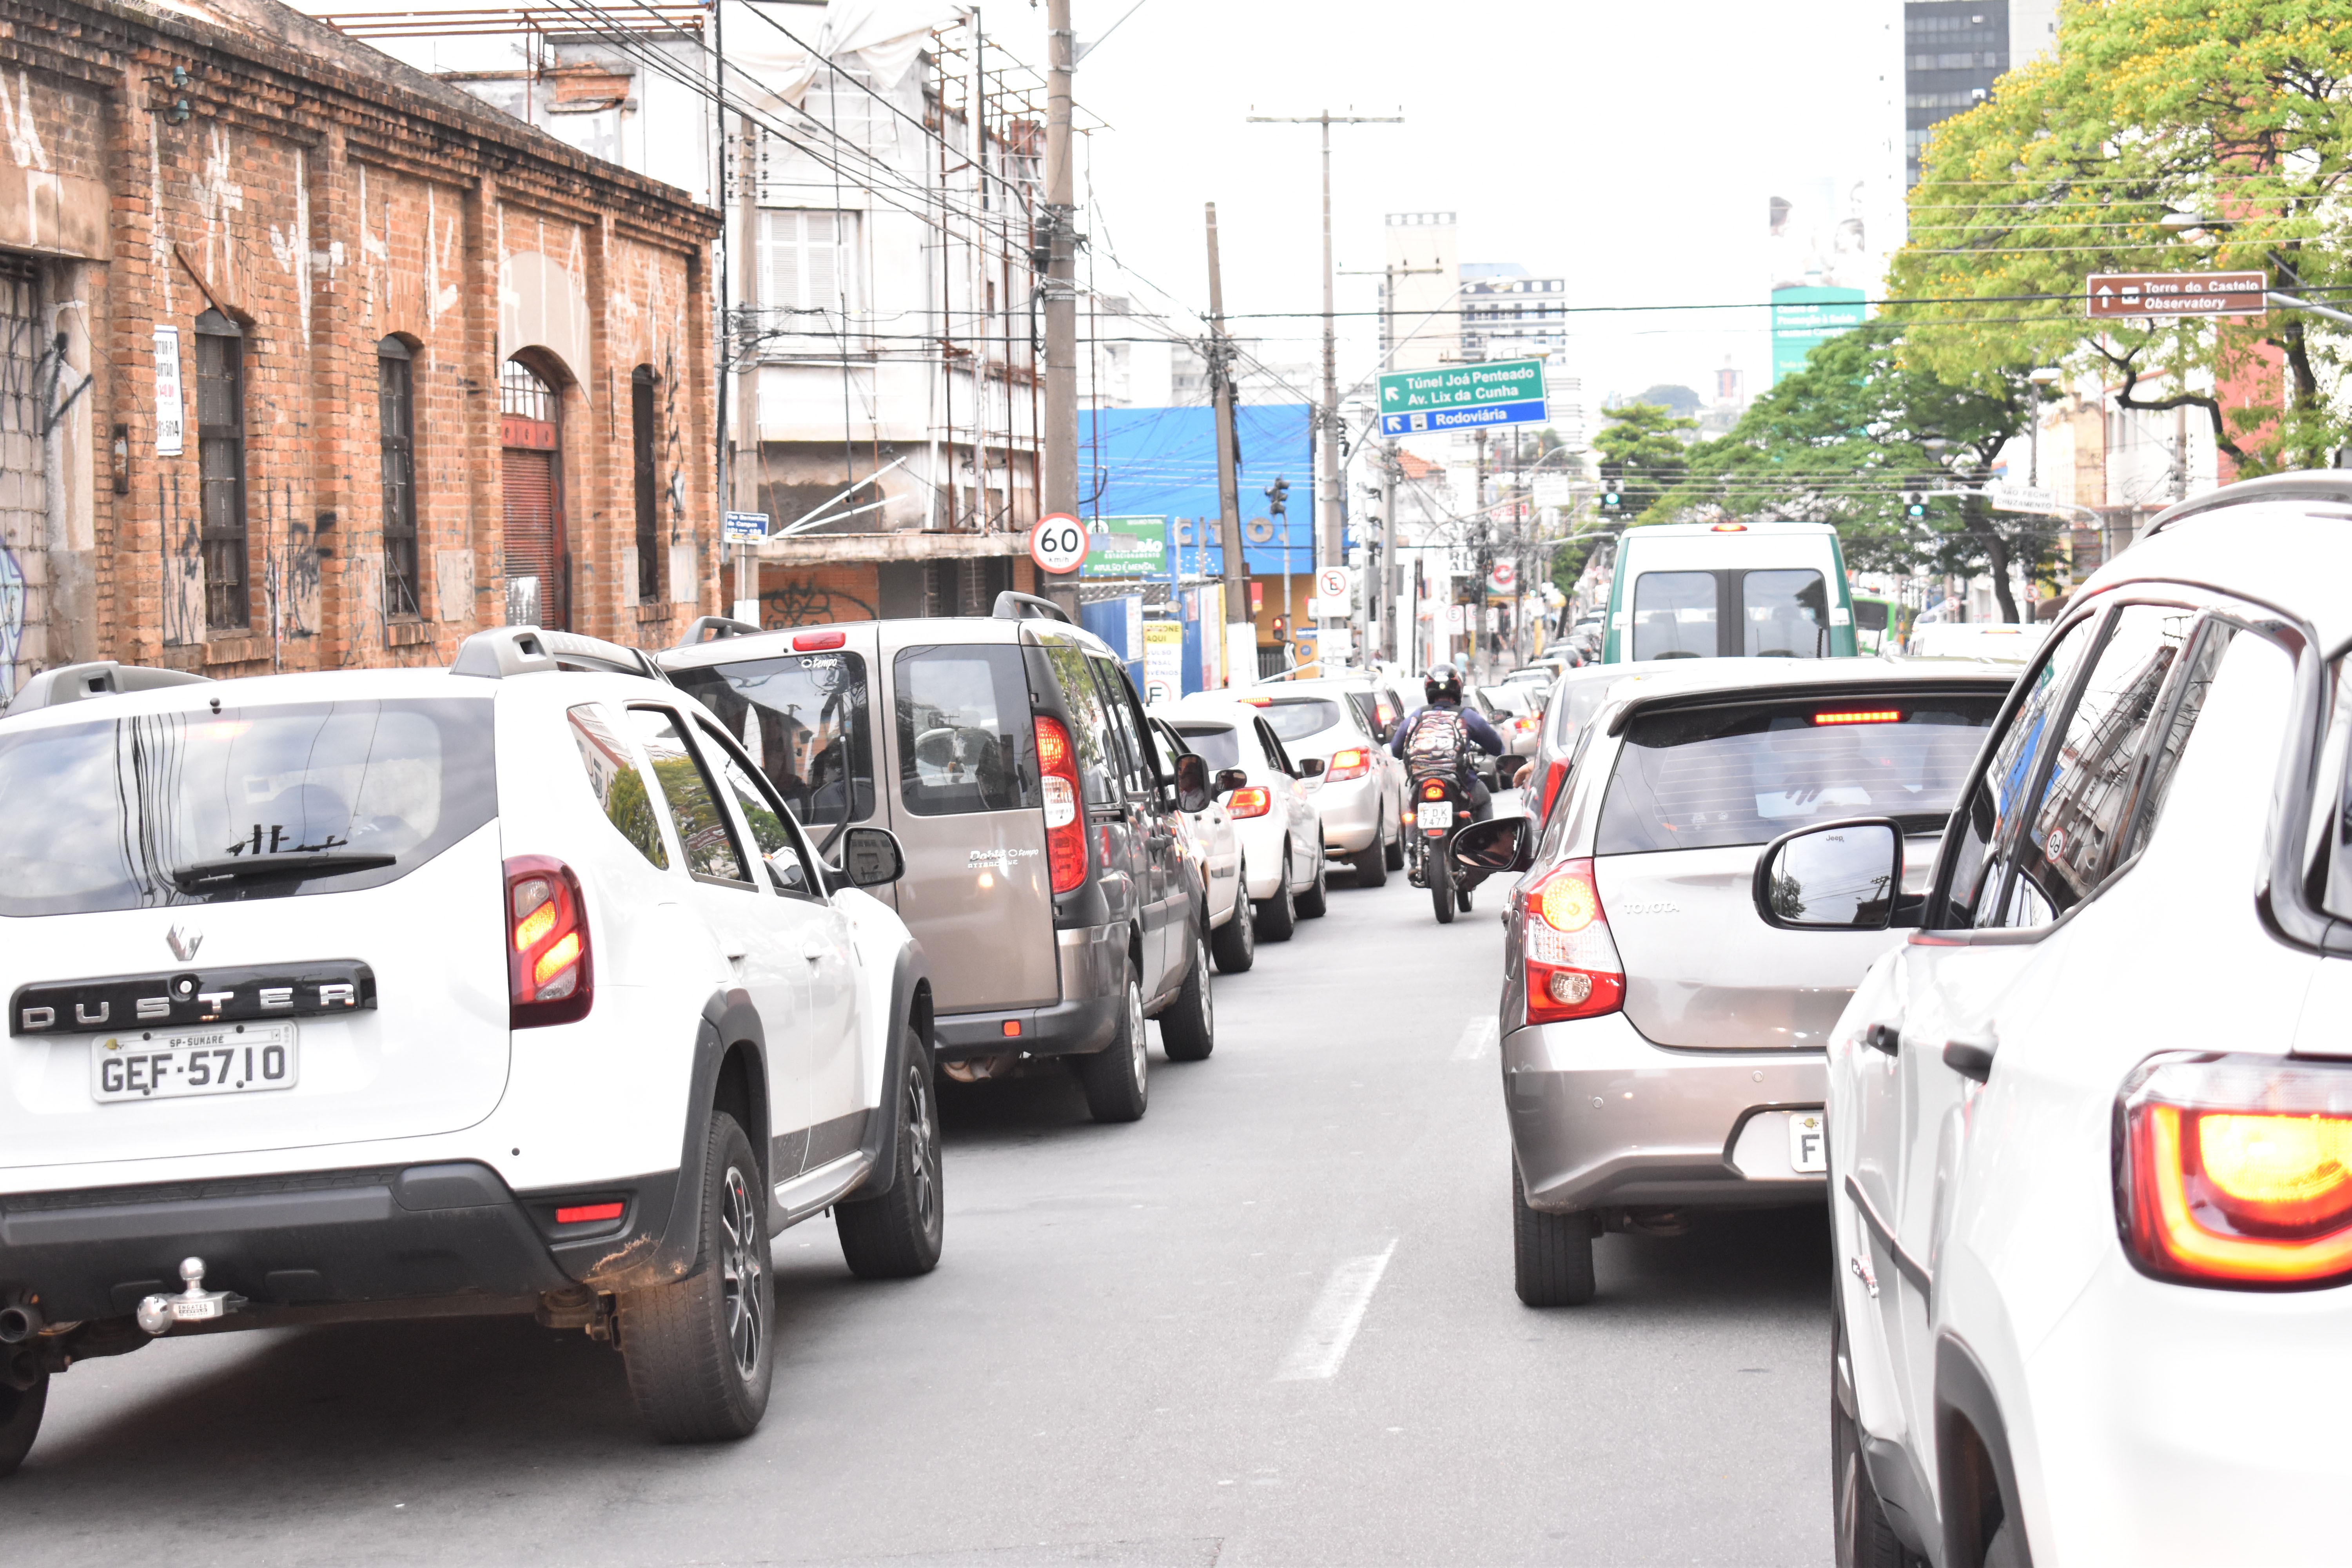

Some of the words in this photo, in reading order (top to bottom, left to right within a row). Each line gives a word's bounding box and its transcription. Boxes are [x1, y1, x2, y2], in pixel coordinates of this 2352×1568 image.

[2144, 282, 2178, 293] Torre
[2185, 281, 2202, 292] do
[2209, 281, 2259, 292] Castelo
[2145, 298, 2226, 310] Observatory
[1406, 375, 1443, 389] Túnel
[1446, 373, 1470, 387] Joá
[1473, 367, 1534, 383] Penteado
[1408, 394, 1428, 405] Av.
[1432, 392, 1452, 404] Lix
[1455, 389, 1472, 401] da
[1475, 385, 1519, 399] Cunha
[1435, 409, 1507, 425] Rodoviária
[1041, 527, 1078, 552] 60
[1422, 817, 1447, 826] 7477
[1624, 901, 1680, 914] TOYOTA
[22, 983, 355, 1029] DUSTER
